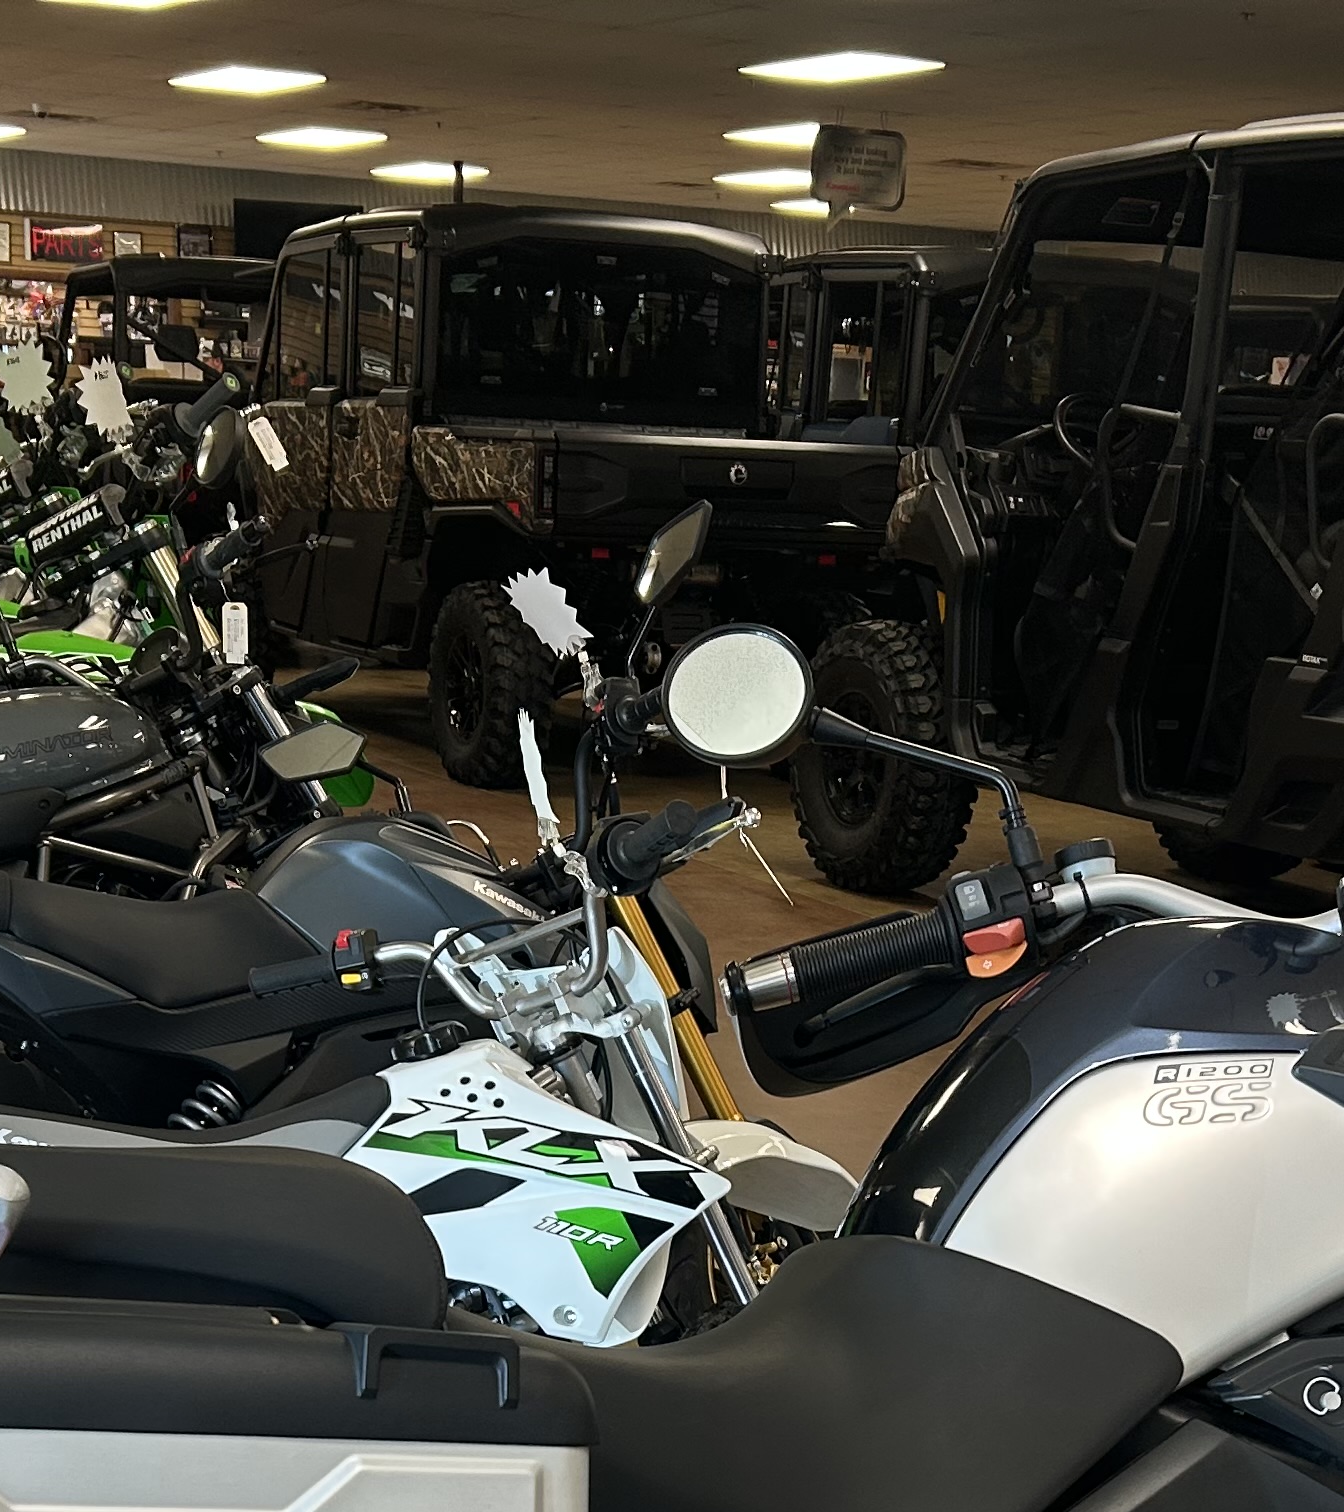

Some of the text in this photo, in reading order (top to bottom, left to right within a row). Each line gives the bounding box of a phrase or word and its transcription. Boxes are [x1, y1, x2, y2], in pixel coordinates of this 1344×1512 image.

[32, 505, 104, 554] RENTHAL
[474, 880, 545, 921] Kawasaki
[1155, 1060, 1272, 1083] R1200
[1143, 1081, 1272, 1126] GS
[376, 1098, 707, 1197] KLX
[533, 1216, 627, 1251] 110R
